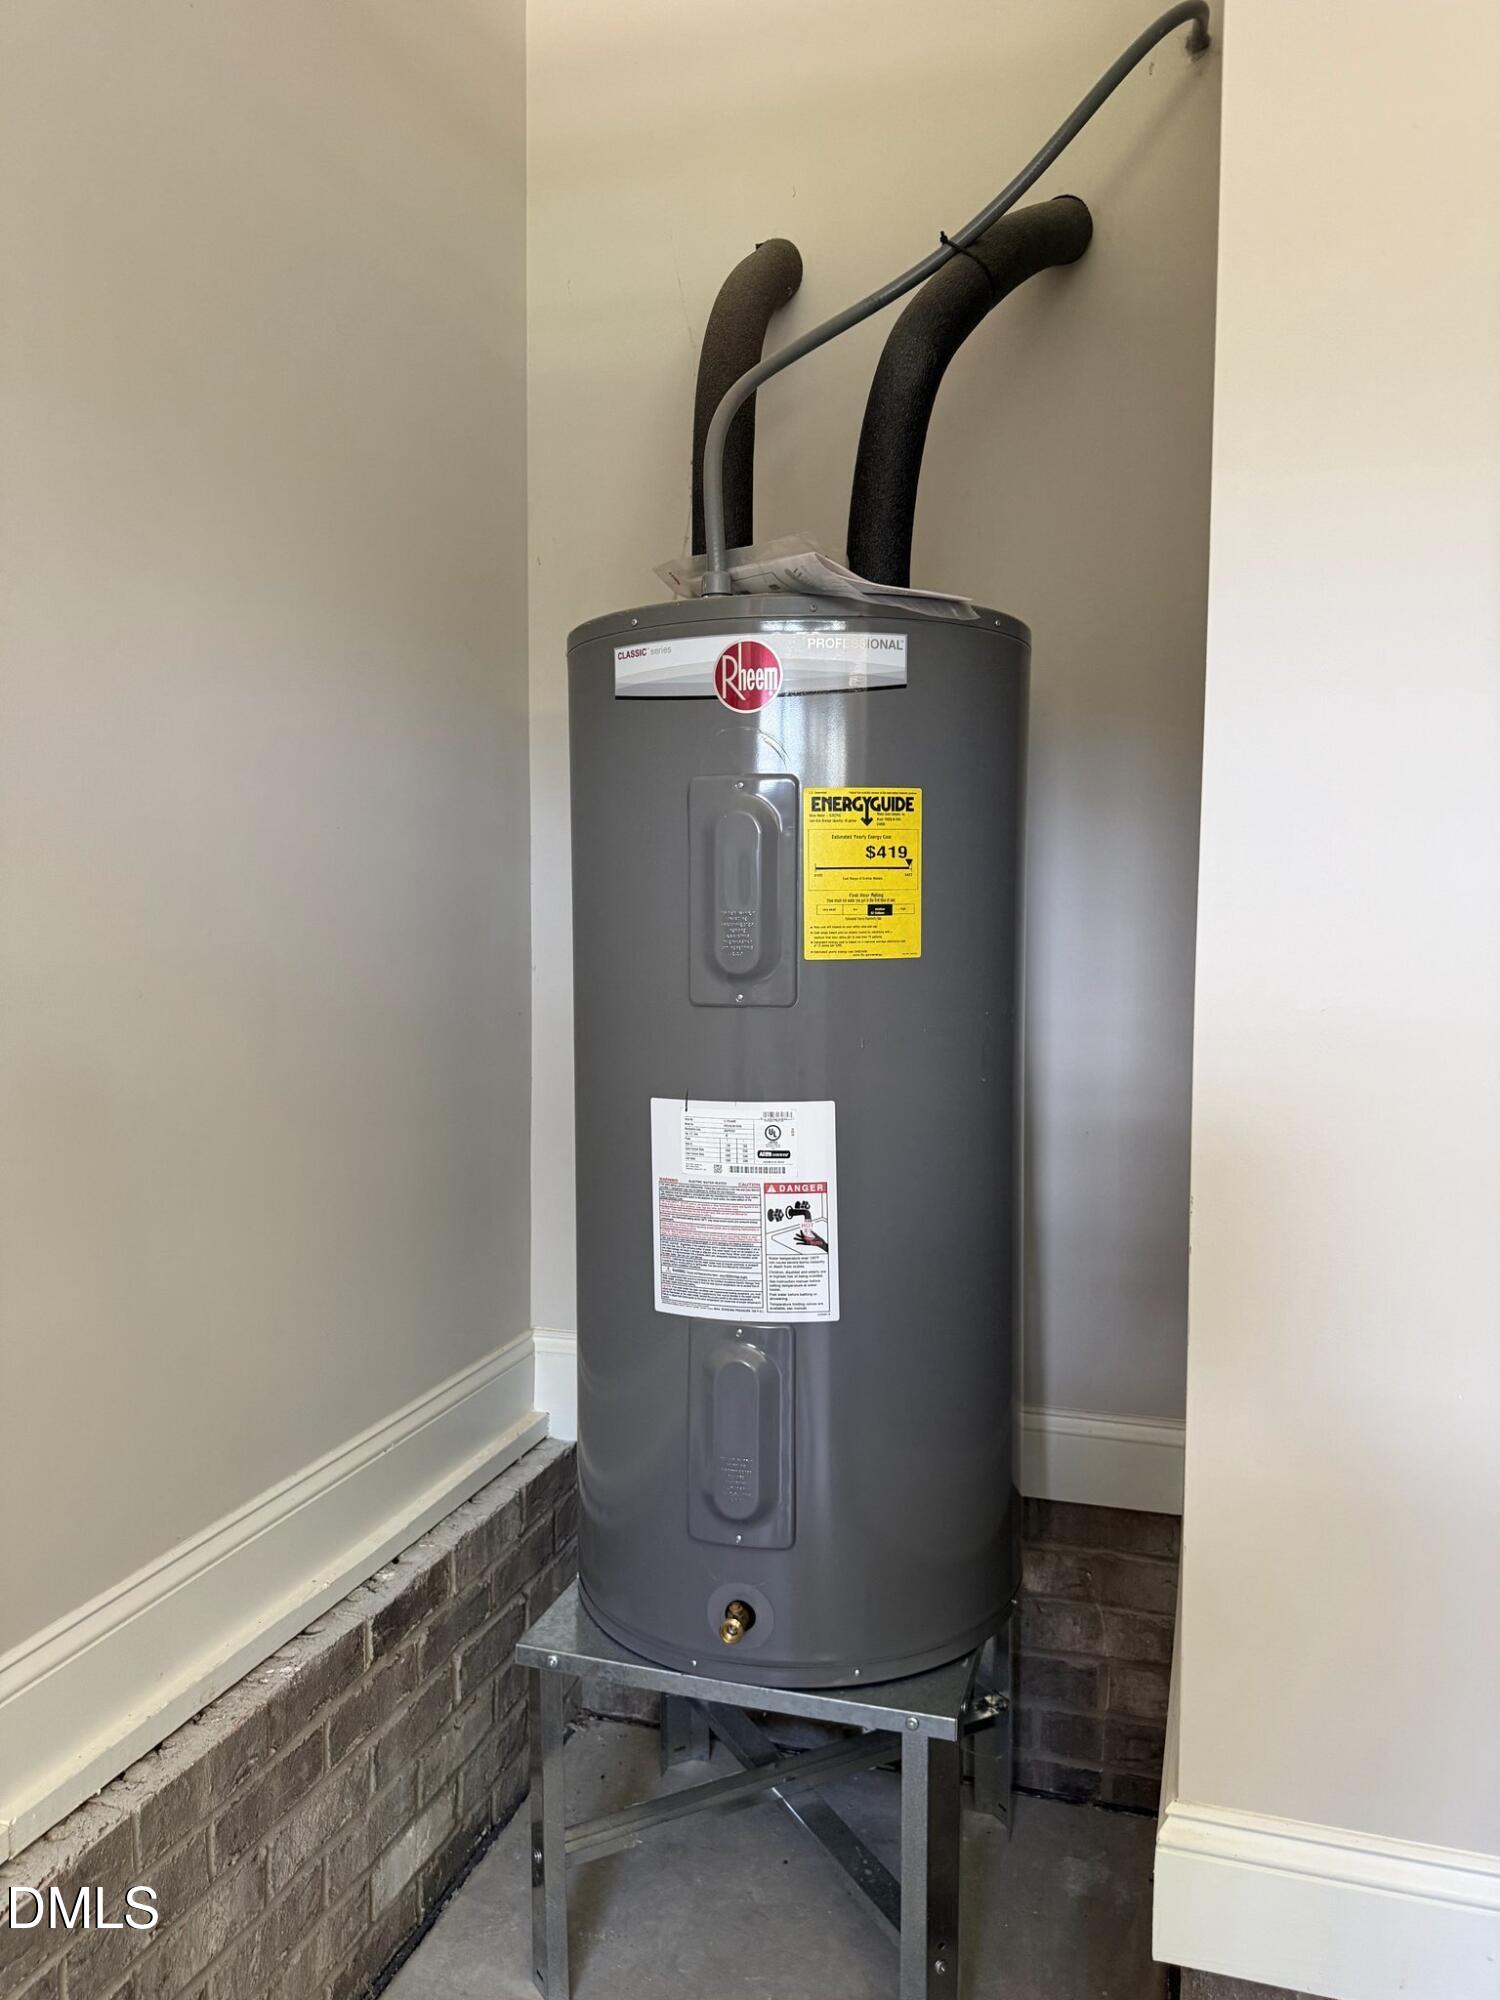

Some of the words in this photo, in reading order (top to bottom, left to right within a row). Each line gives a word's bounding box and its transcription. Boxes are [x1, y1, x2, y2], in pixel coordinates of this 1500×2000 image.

[617, 648, 648, 660] CLASSIC
[650, 646, 672, 655] series
[722, 642, 778, 700] Rheem
[811, 796, 915, 818] ENERGYGUIDE
[865, 845, 908, 860] $419
[768, 1128, 777, 1138] UL
[779, 1184, 823, 1192] DANGER
